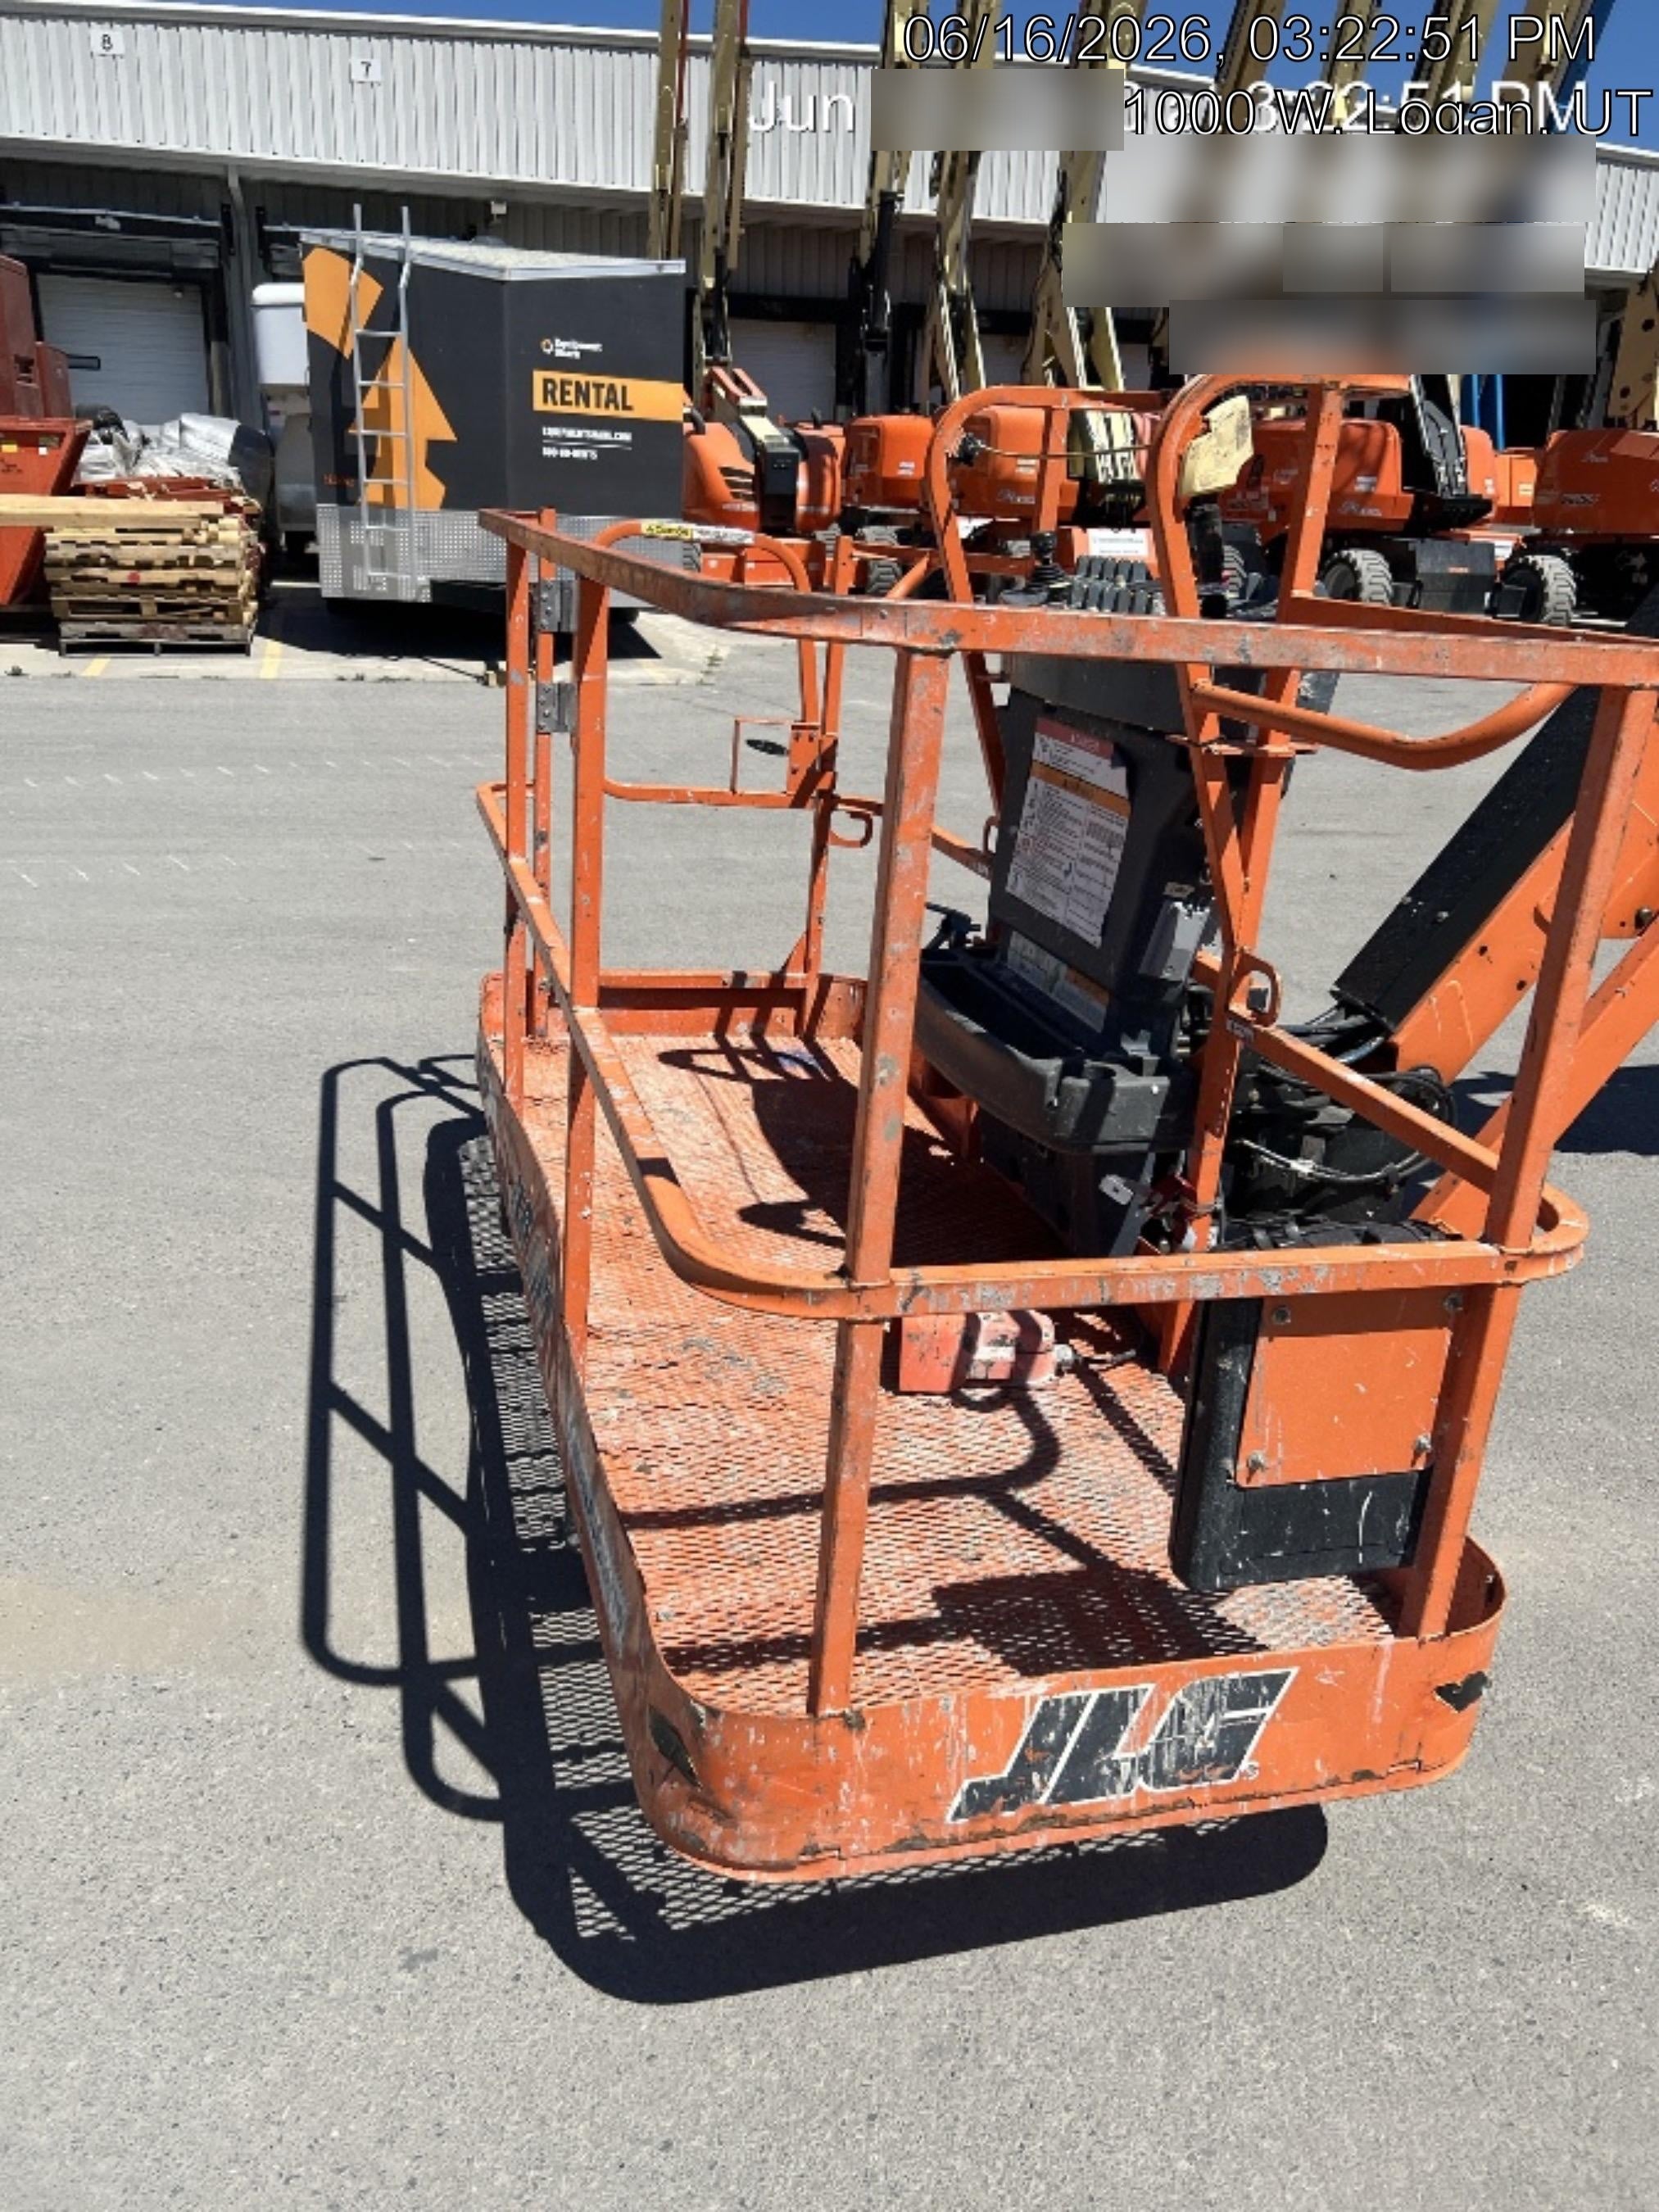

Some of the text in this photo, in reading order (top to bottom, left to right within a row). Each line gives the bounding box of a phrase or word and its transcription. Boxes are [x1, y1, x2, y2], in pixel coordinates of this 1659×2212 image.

[102, 34, 113, 51] 8
[360, 61, 371, 77] 7
[542, 378, 634, 411] RENTAL
[945, 1666, 1300, 1824] JLG
